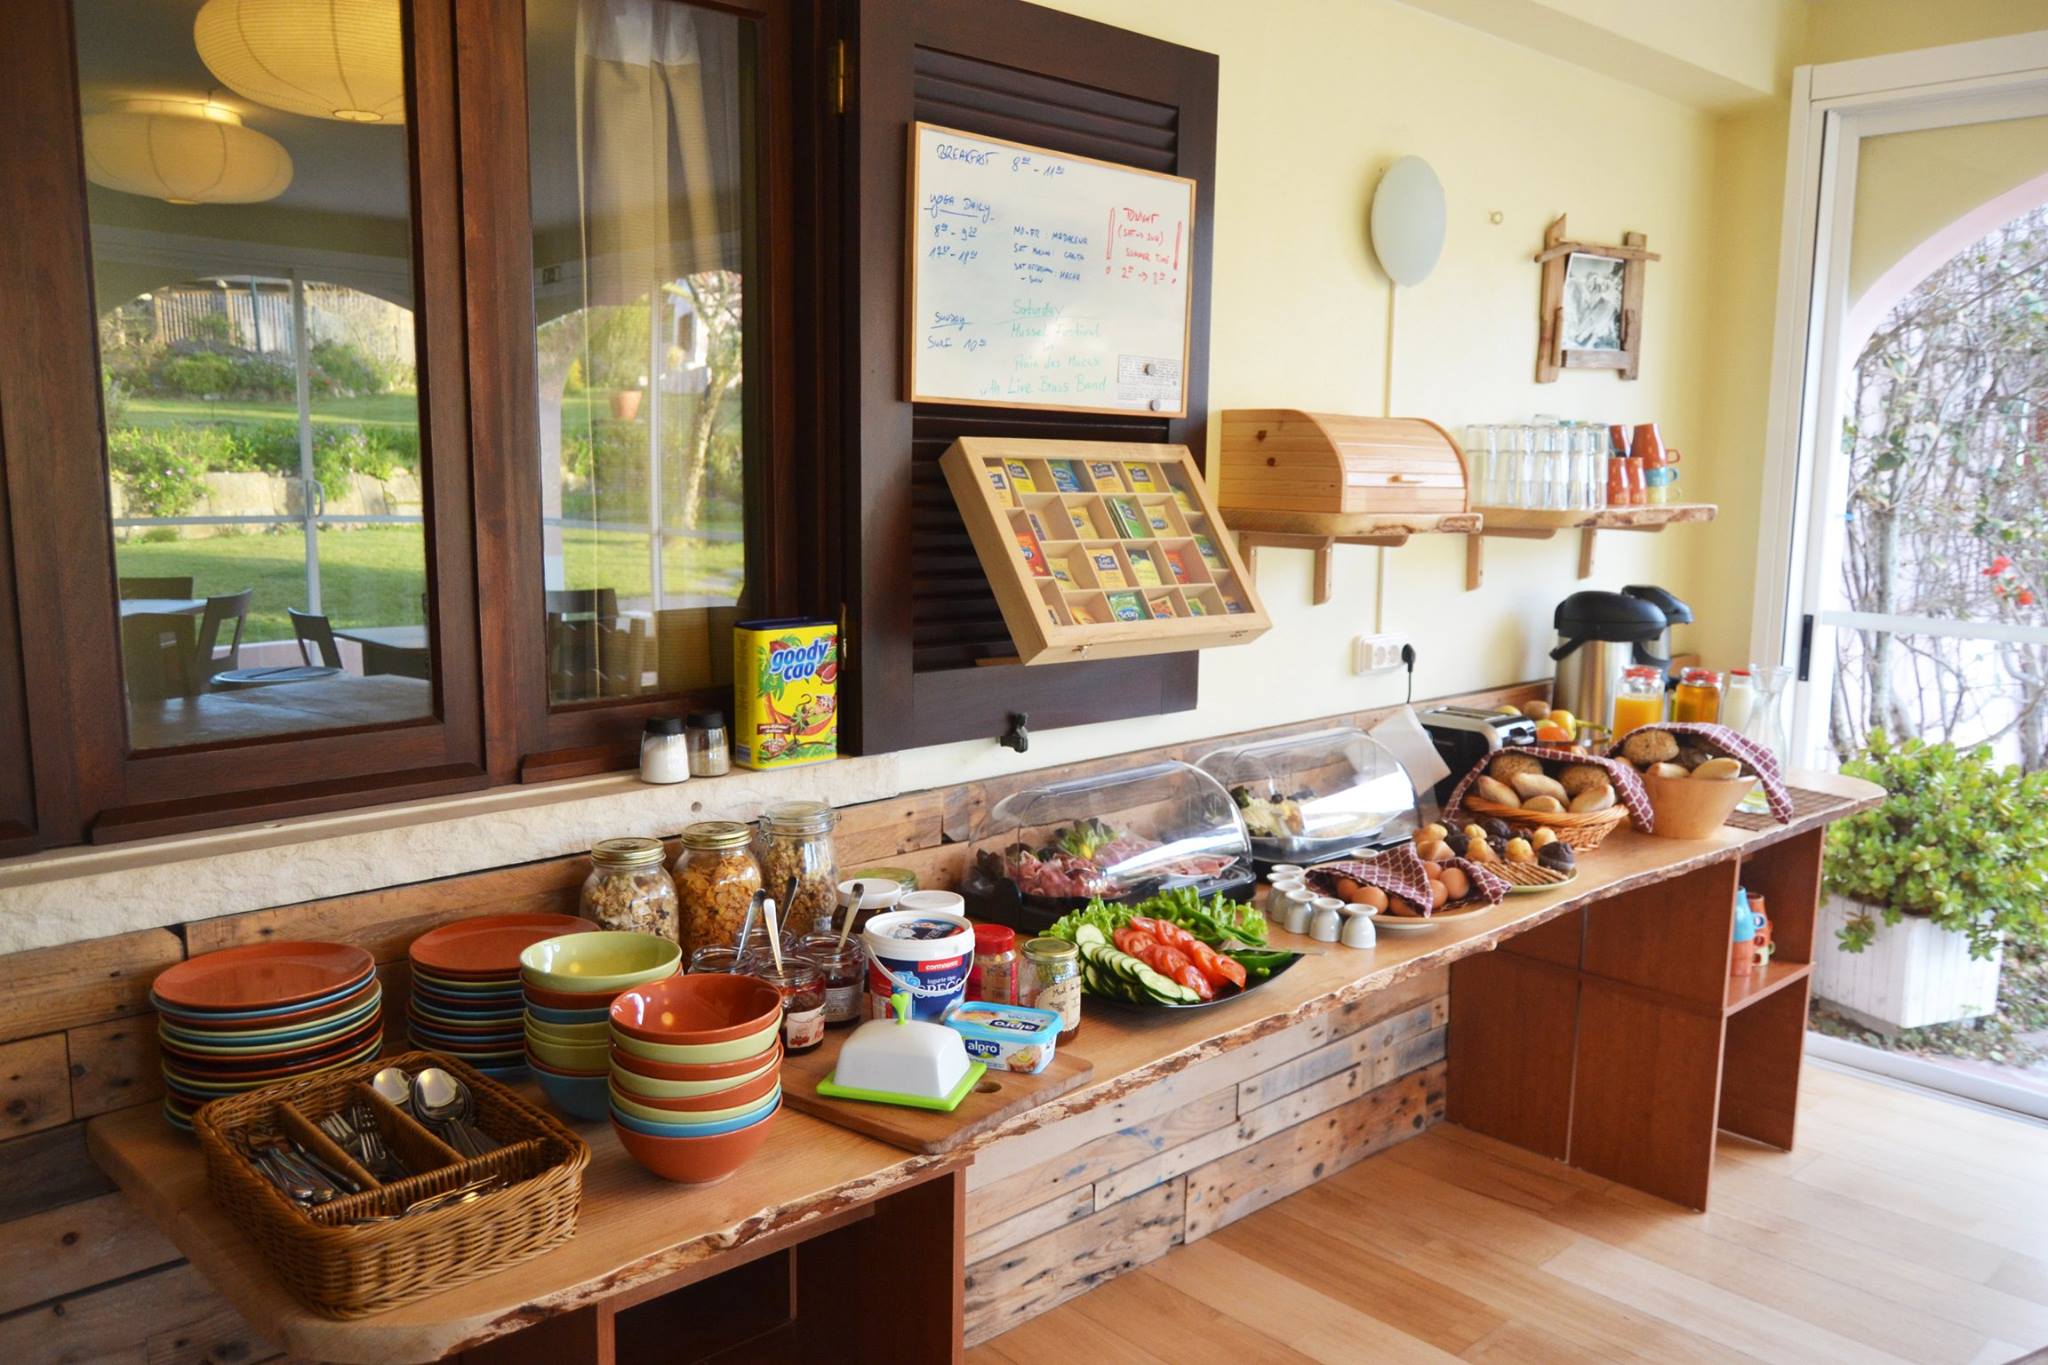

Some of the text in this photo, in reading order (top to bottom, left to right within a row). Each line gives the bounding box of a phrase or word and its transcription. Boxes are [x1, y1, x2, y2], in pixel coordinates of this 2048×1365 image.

[936, 144, 998, 166] BREAKFAST
[1008, 376, 1032, 394] Live
[1040, 376, 1071, 393] Brass
[1075, 374, 1107, 393] Band
[770, 638, 829, 672] goody
[783, 661, 816, 681] cao
[993, 1020, 1036, 1031] alpro
[967, 1041, 998, 1054] alpro
